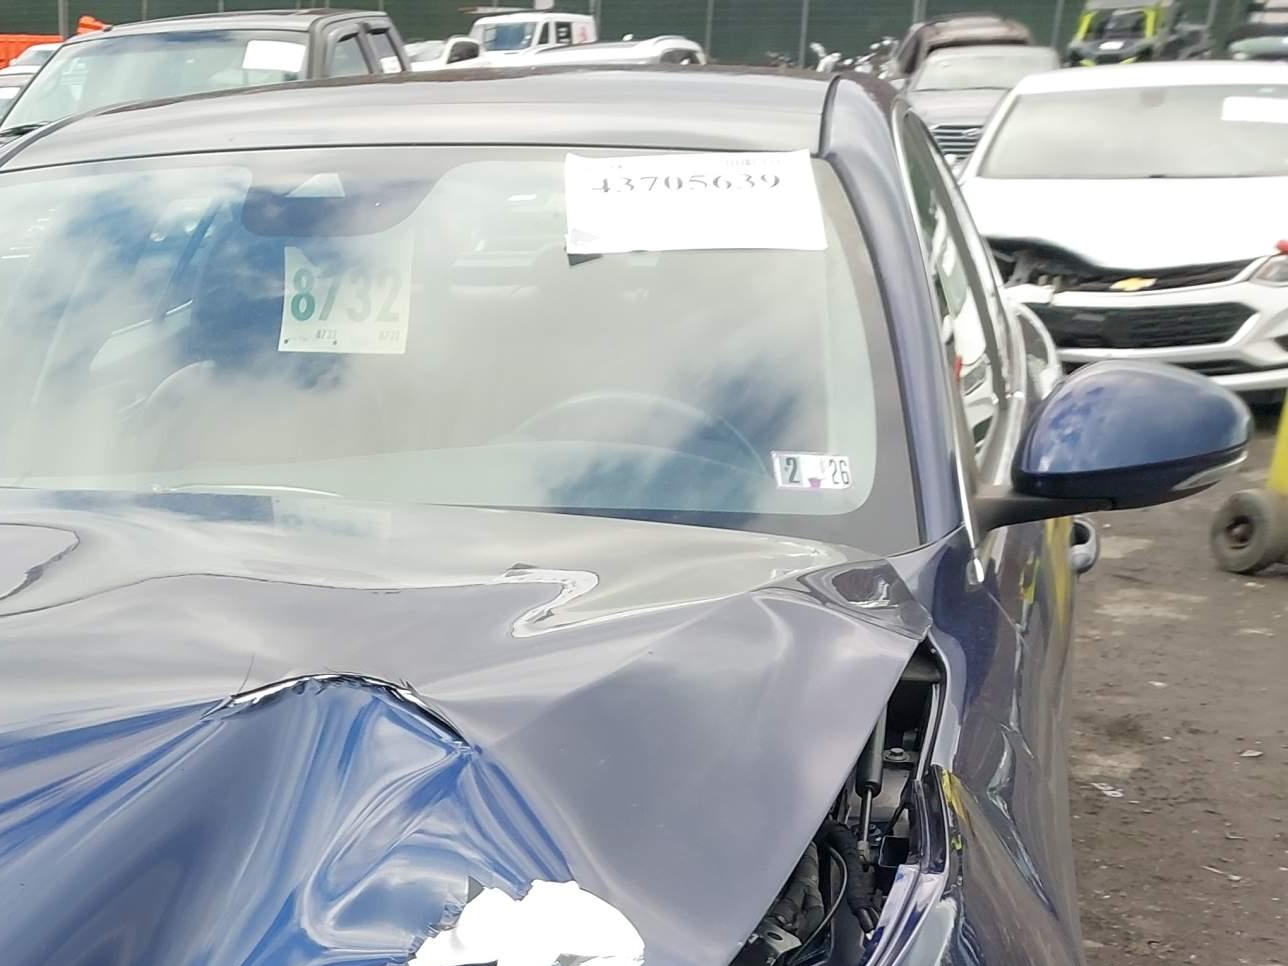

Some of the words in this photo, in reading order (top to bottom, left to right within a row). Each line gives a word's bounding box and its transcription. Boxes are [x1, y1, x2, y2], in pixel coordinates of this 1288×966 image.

[591, 172, 781, 194] 43705639
[290, 267, 403, 322] 8732
[785, 456, 801, 484] 2
[828, 458, 850, 485] 26
